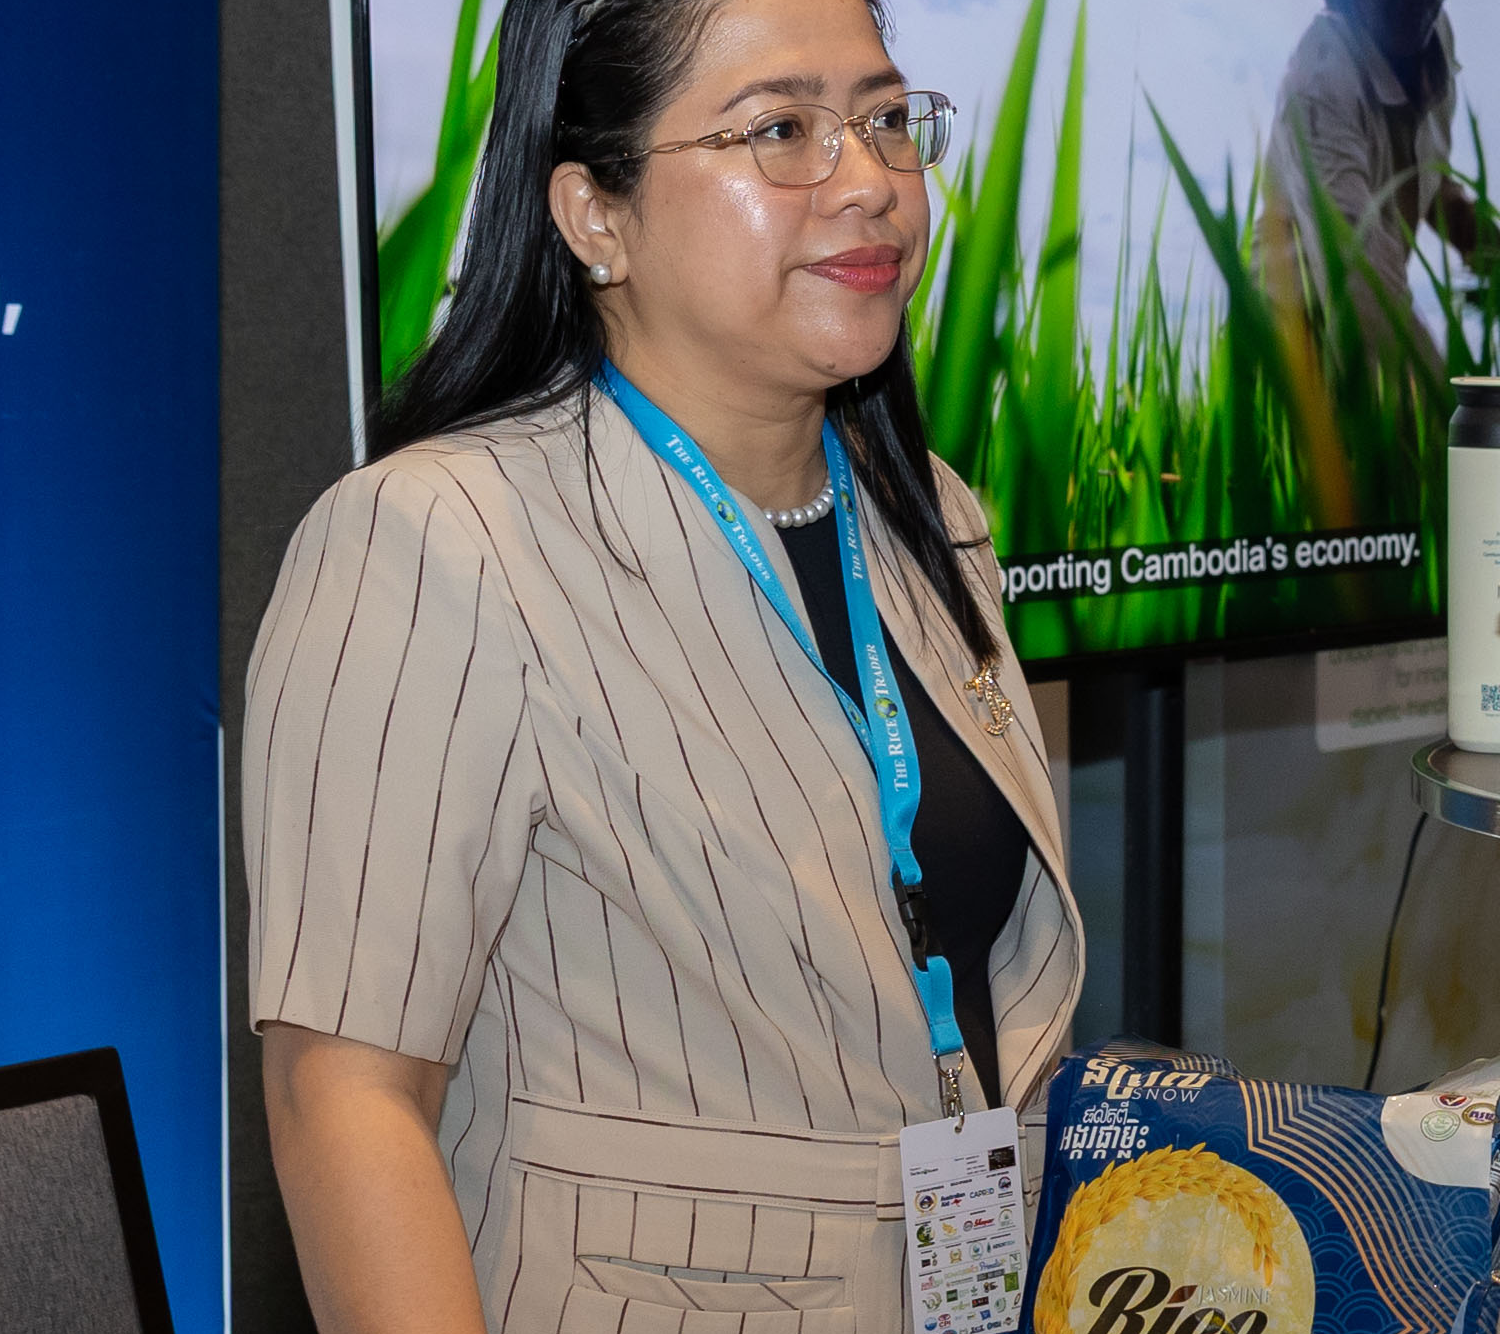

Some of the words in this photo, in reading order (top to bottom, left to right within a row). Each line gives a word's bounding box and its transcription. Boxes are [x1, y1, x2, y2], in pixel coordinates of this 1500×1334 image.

[1000, 551, 1111, 603] porting
[1120, 536, 1287, 584] Cambodia's
[1295, 531, 1421, 566] economy.
[886, 717, 905, 756] RICE
[1131, 1088, 1201, 1103] SNOW
[1197, 1283, 1272, 1304] JASMINE
